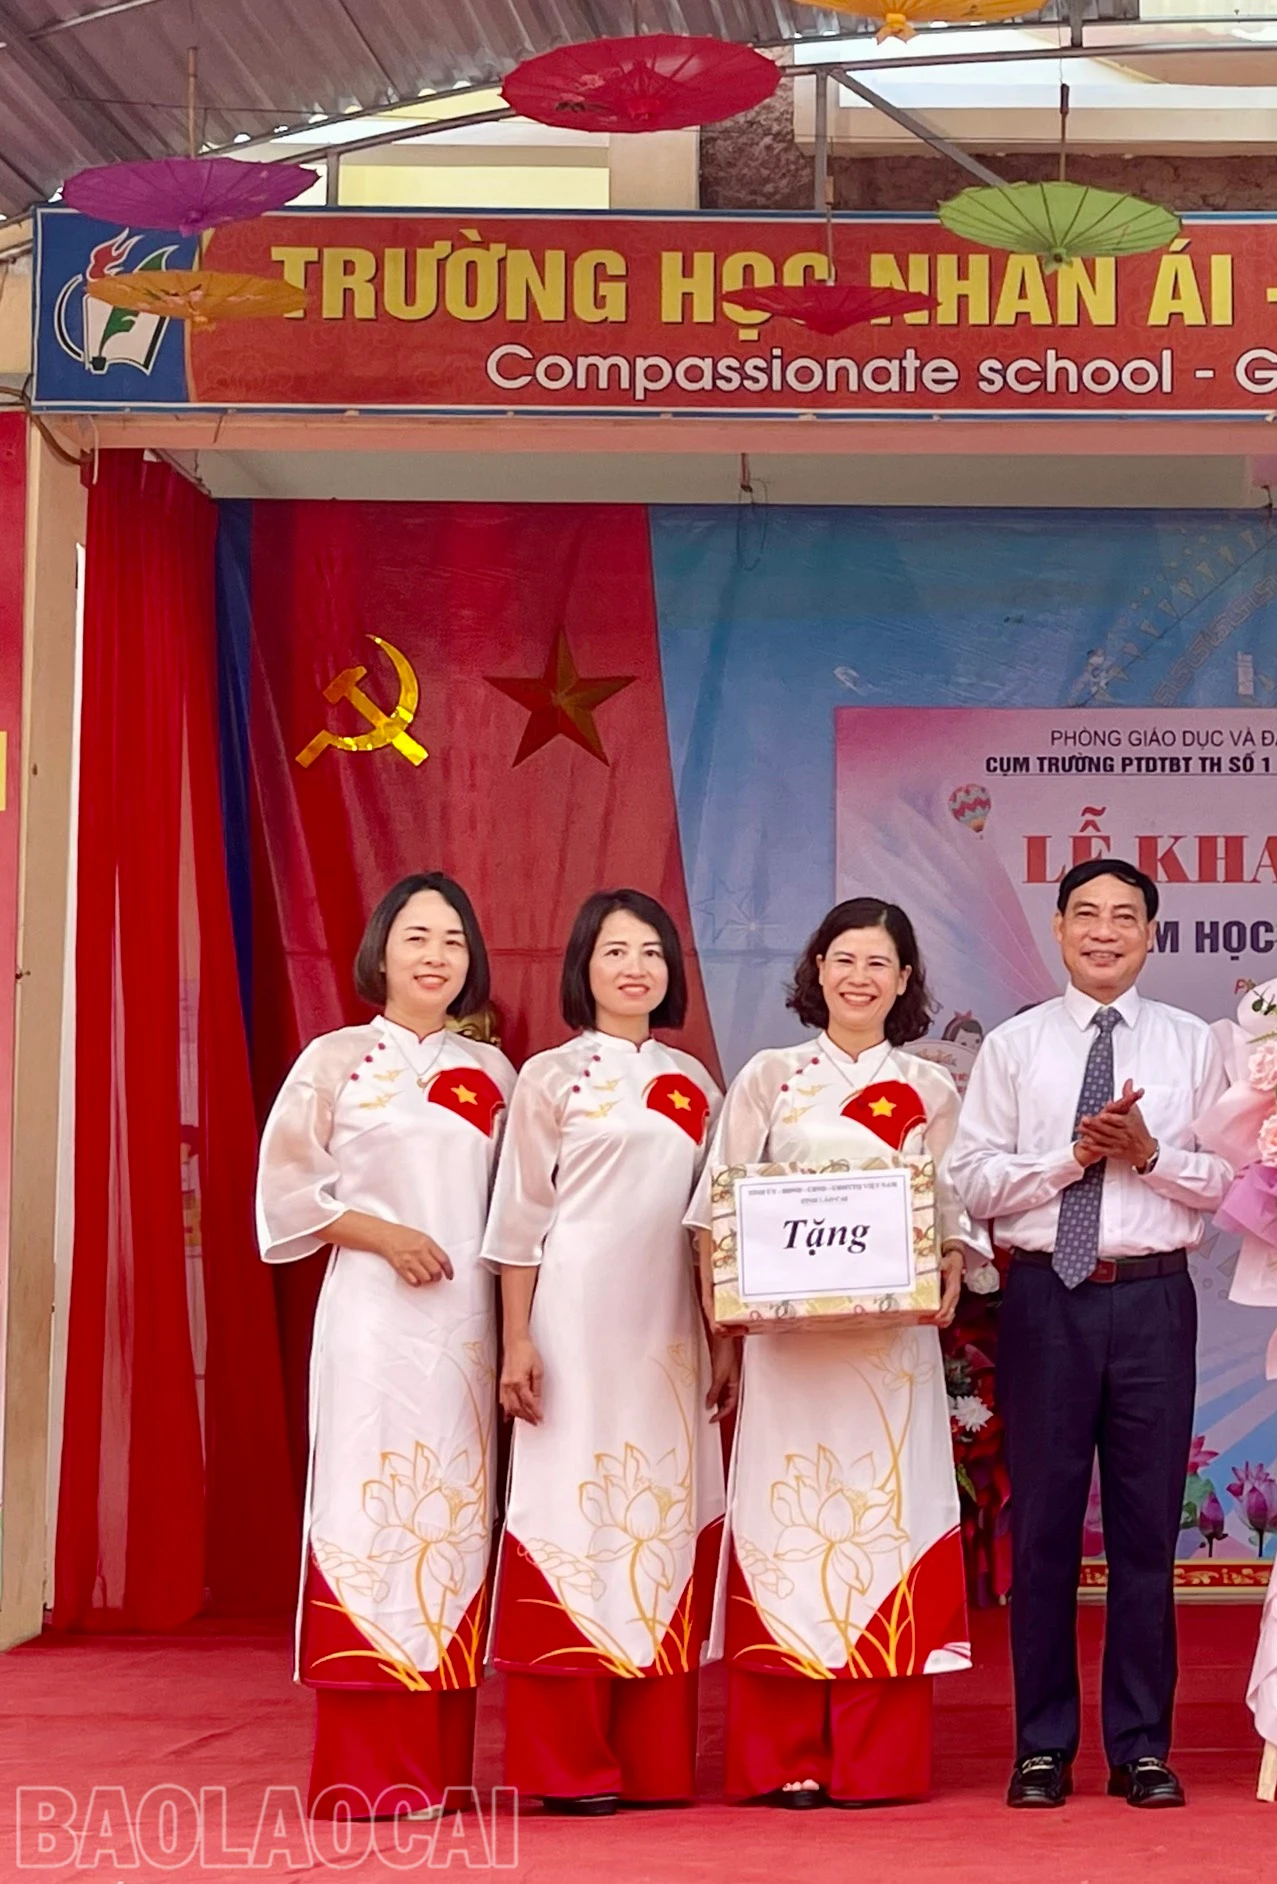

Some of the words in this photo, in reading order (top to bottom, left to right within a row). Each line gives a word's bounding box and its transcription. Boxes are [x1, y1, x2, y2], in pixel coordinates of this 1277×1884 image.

[271, 229, 628, 323] TRƯỜNG
[1148, 239, 1232, 326] ÁI
[486, 343, 960, 400] Compassionate
[978, 349, 1172, 394] school
[1195, 368, 1215, 379] -
[1050, 726, 1122, 747] PHÒNG
[1128, 727, 1176, 747] GIÁO
[1182, 729, 1224, 750] DỤC
[1229, 727, 1256, 747] VÀ
[985, 756, 1030, 777] CỤM
[1036, 752, 1115, 773] TRƯỜNG
[1121, 756, 1193, 773] PTDTBT
[1198, 756, 1222, 773] TH
[1229, 751, 1255, 773] SỐ
[1261, 756, 1271, 773] 1
[1195, 920, 1275, 960] HỌC
[783, 1217, 870, 1256] Tặng
